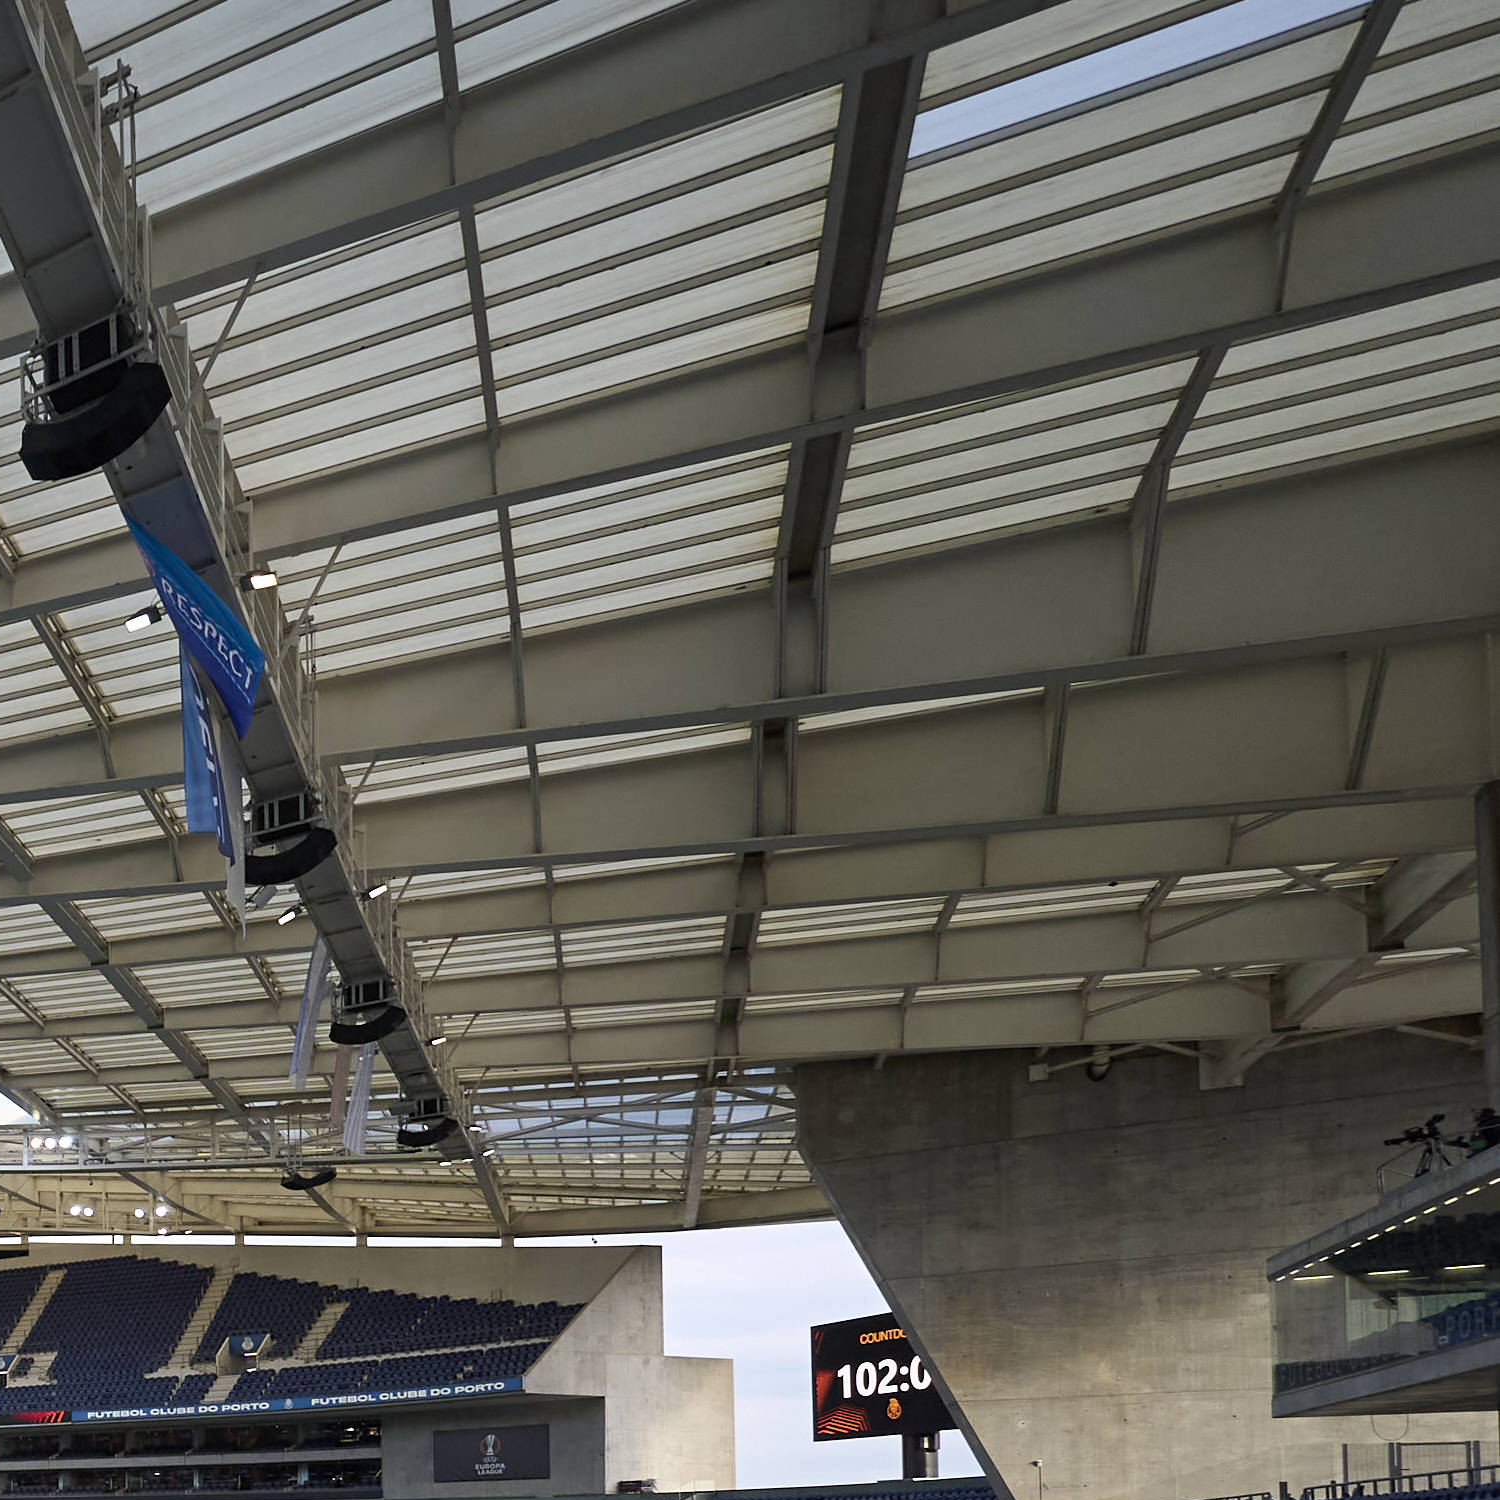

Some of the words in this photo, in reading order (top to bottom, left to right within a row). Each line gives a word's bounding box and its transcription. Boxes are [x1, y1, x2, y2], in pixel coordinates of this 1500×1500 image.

[161, 577, 253, 690] RESPECT
[311, 1394, 376, 1406] FUTEBOL
[379, 1390, 427, 1400] CLUBE
[430, 1388, 451, 1396] DO
[454, 1382, 504, 1394] PORTO
[87, 1408, 147, 1419] FUTEBOL
[150, 1406, 195, 1416] CLUBE
[221, 1402, 270, 1412] PORTO
